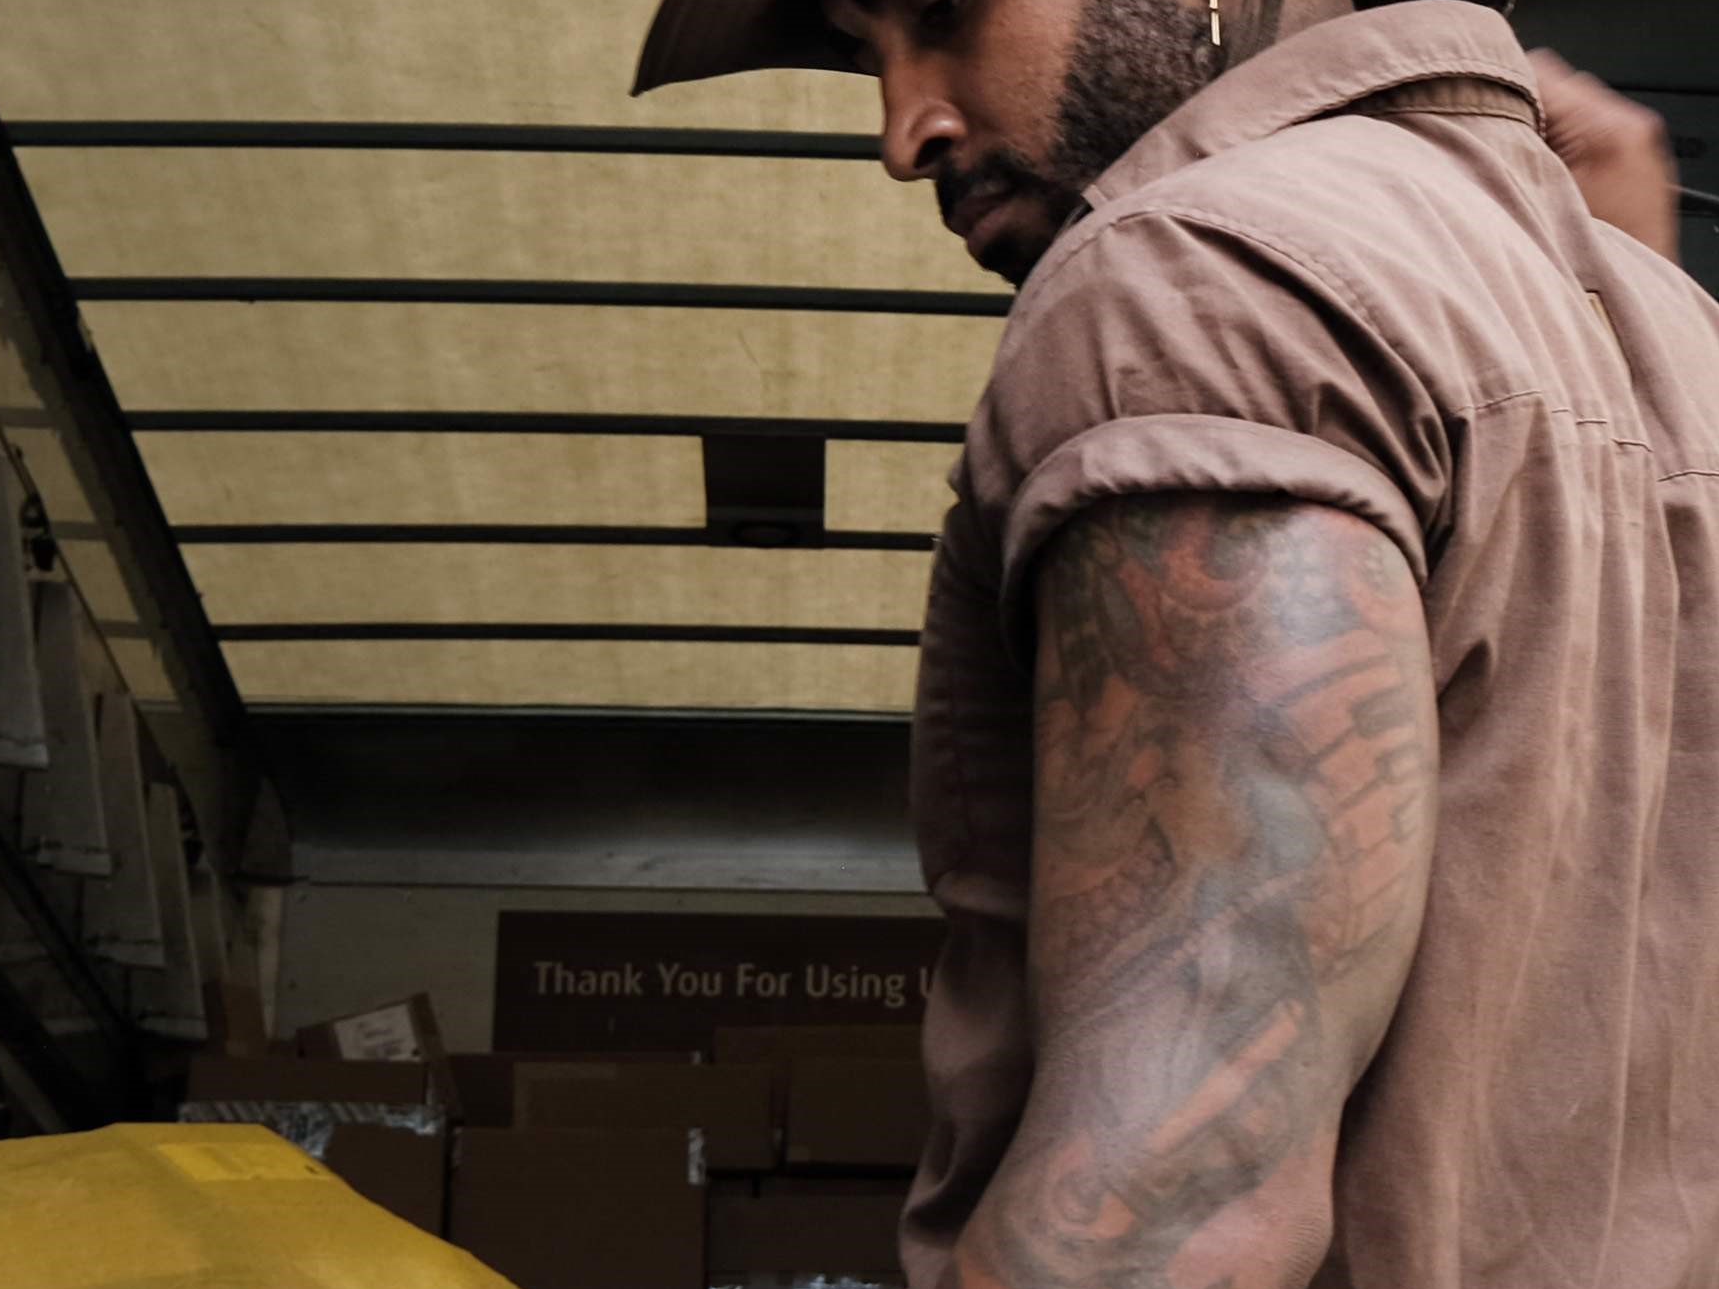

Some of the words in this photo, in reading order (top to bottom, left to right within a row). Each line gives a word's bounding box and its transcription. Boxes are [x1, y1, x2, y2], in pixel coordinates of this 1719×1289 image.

[534, 960, 644, 997] Thank
[658, 962, 723, 998] You
[736, 963, 790, 999] For
[806, 966, 906, 1008] Using
